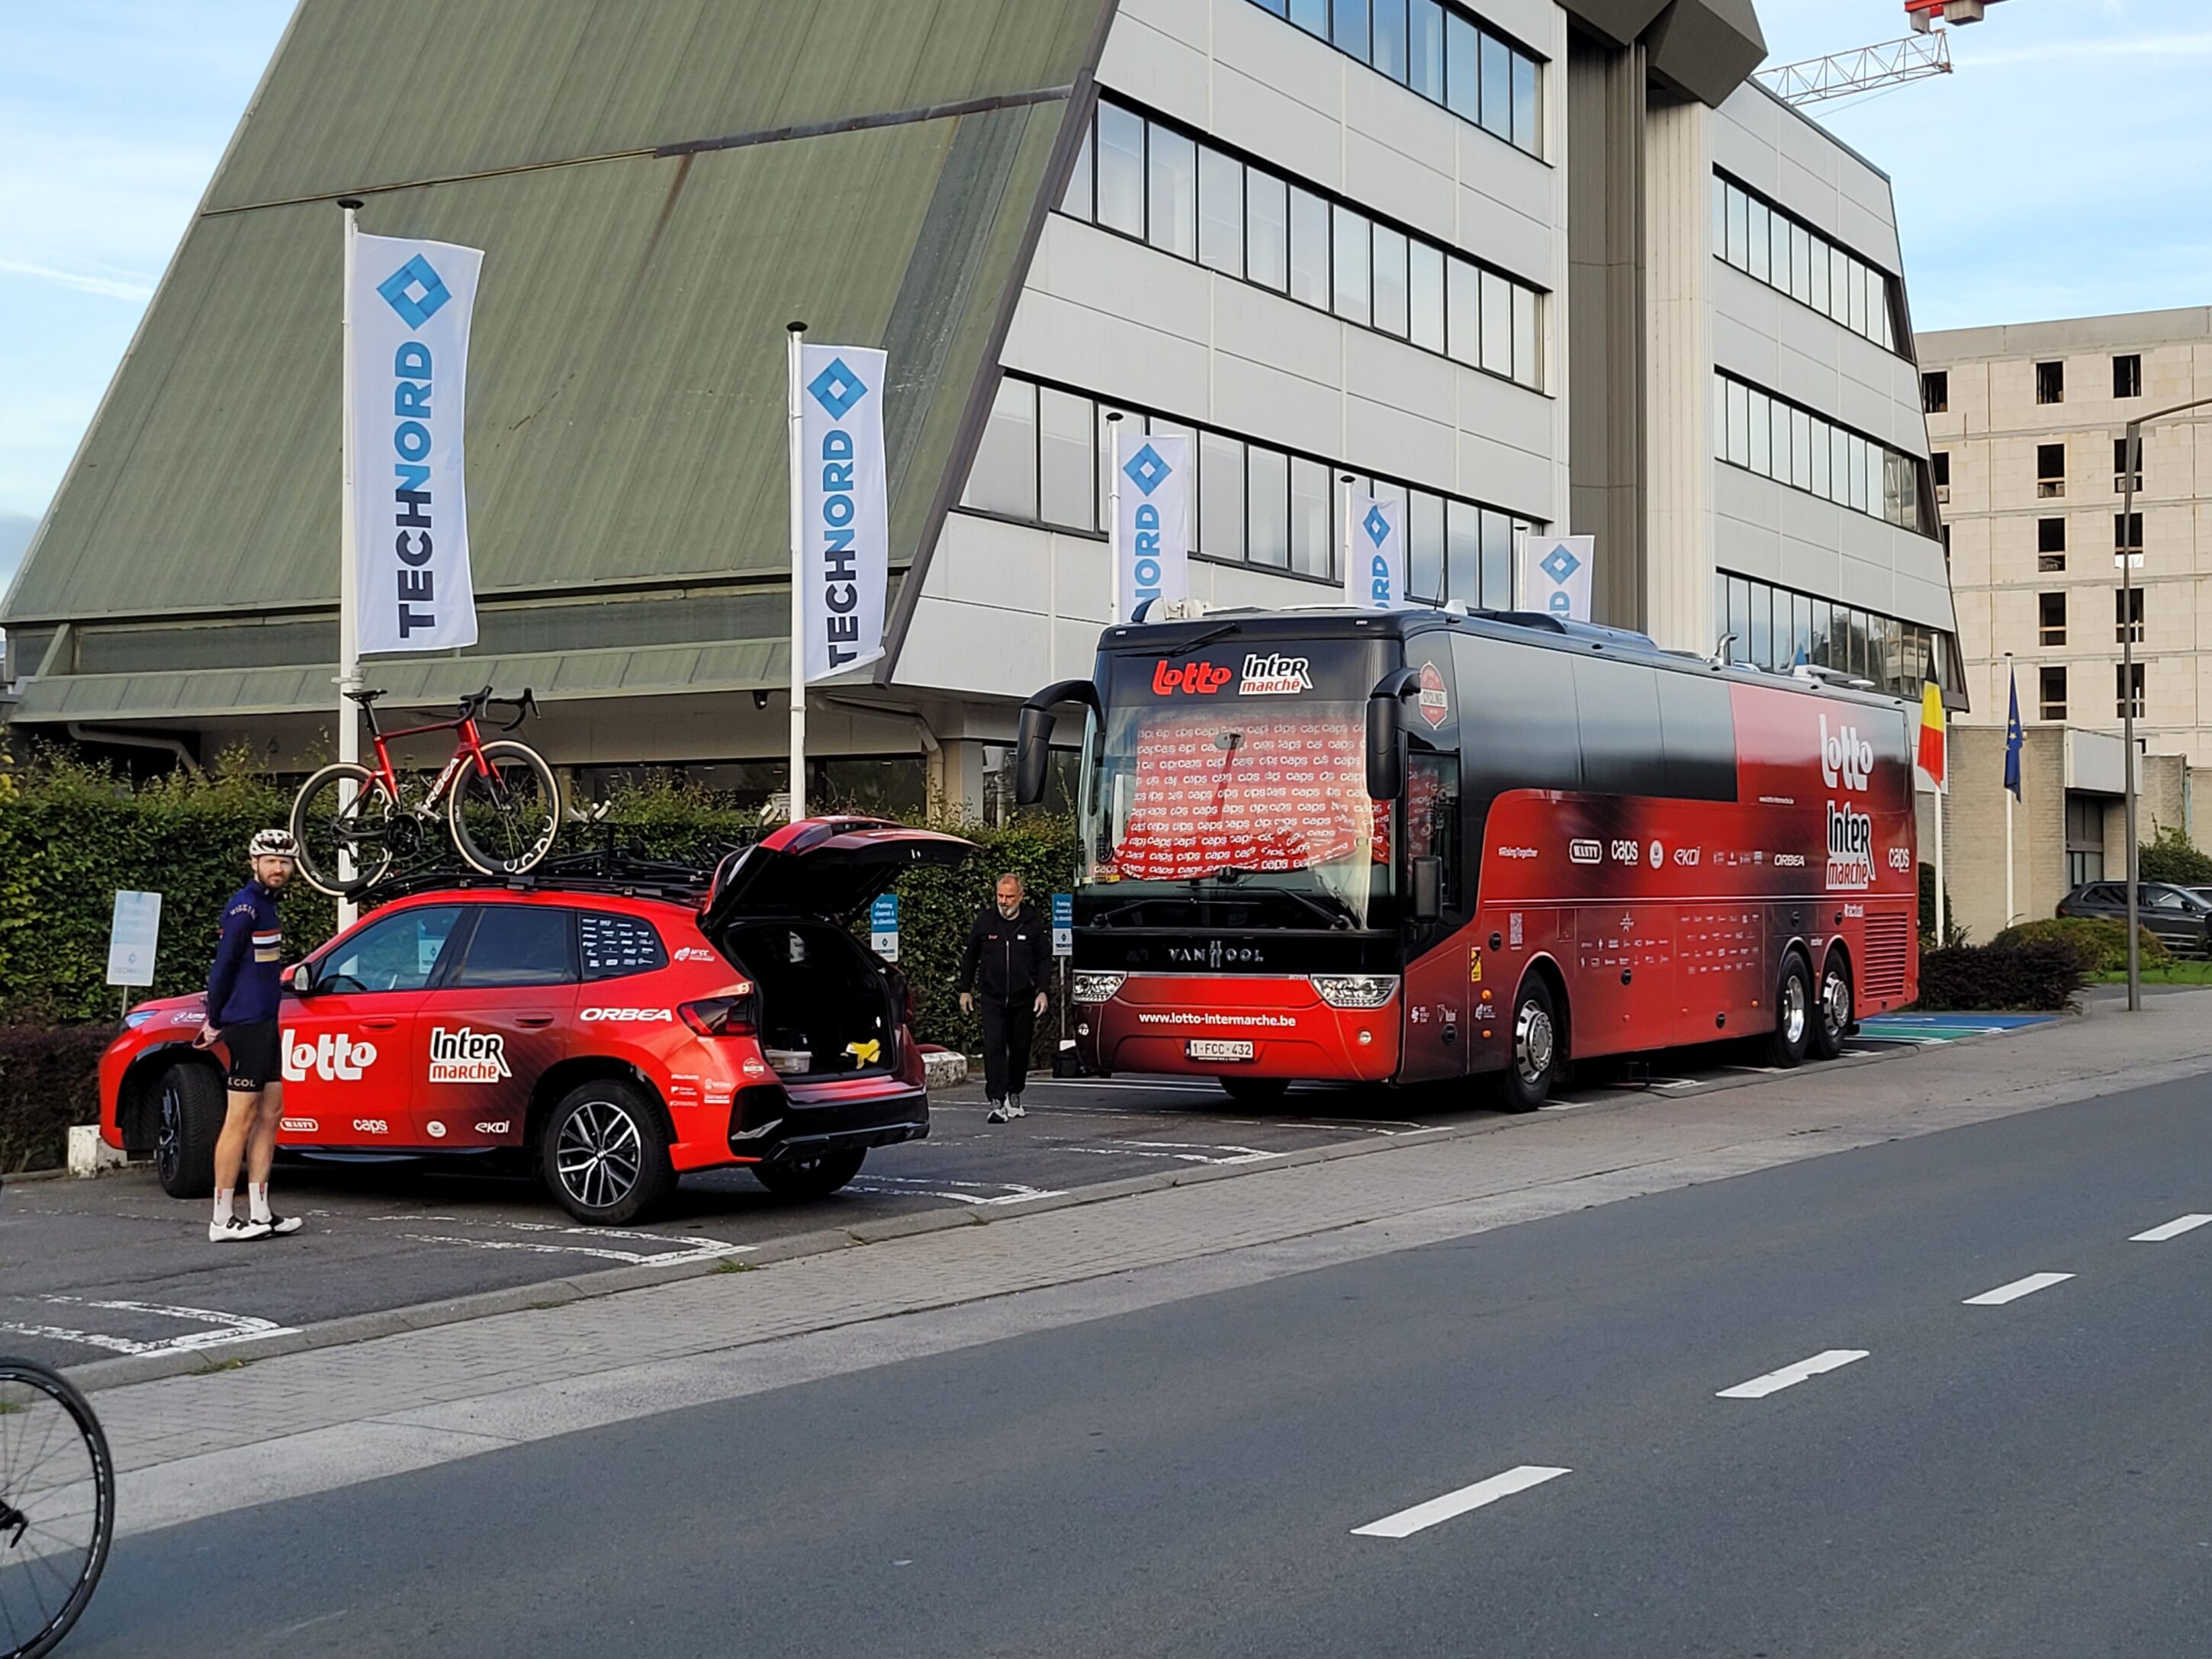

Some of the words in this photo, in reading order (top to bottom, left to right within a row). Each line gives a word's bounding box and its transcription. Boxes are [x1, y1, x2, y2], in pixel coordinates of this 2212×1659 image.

[394, 340, 436, 638] TECHNORD
[821, 429, 860, 669] TECHNORD
[1611, 840, 1638, 864] caps
[1774, 854, 1805, 866] ORBEA
[1889, 848, 1910, 870] caps
[1169, 949, 1206, 961] VAN
[580, 1008, 673, 1022] ORBEA
[353, 1118, 387, 1133] caps
